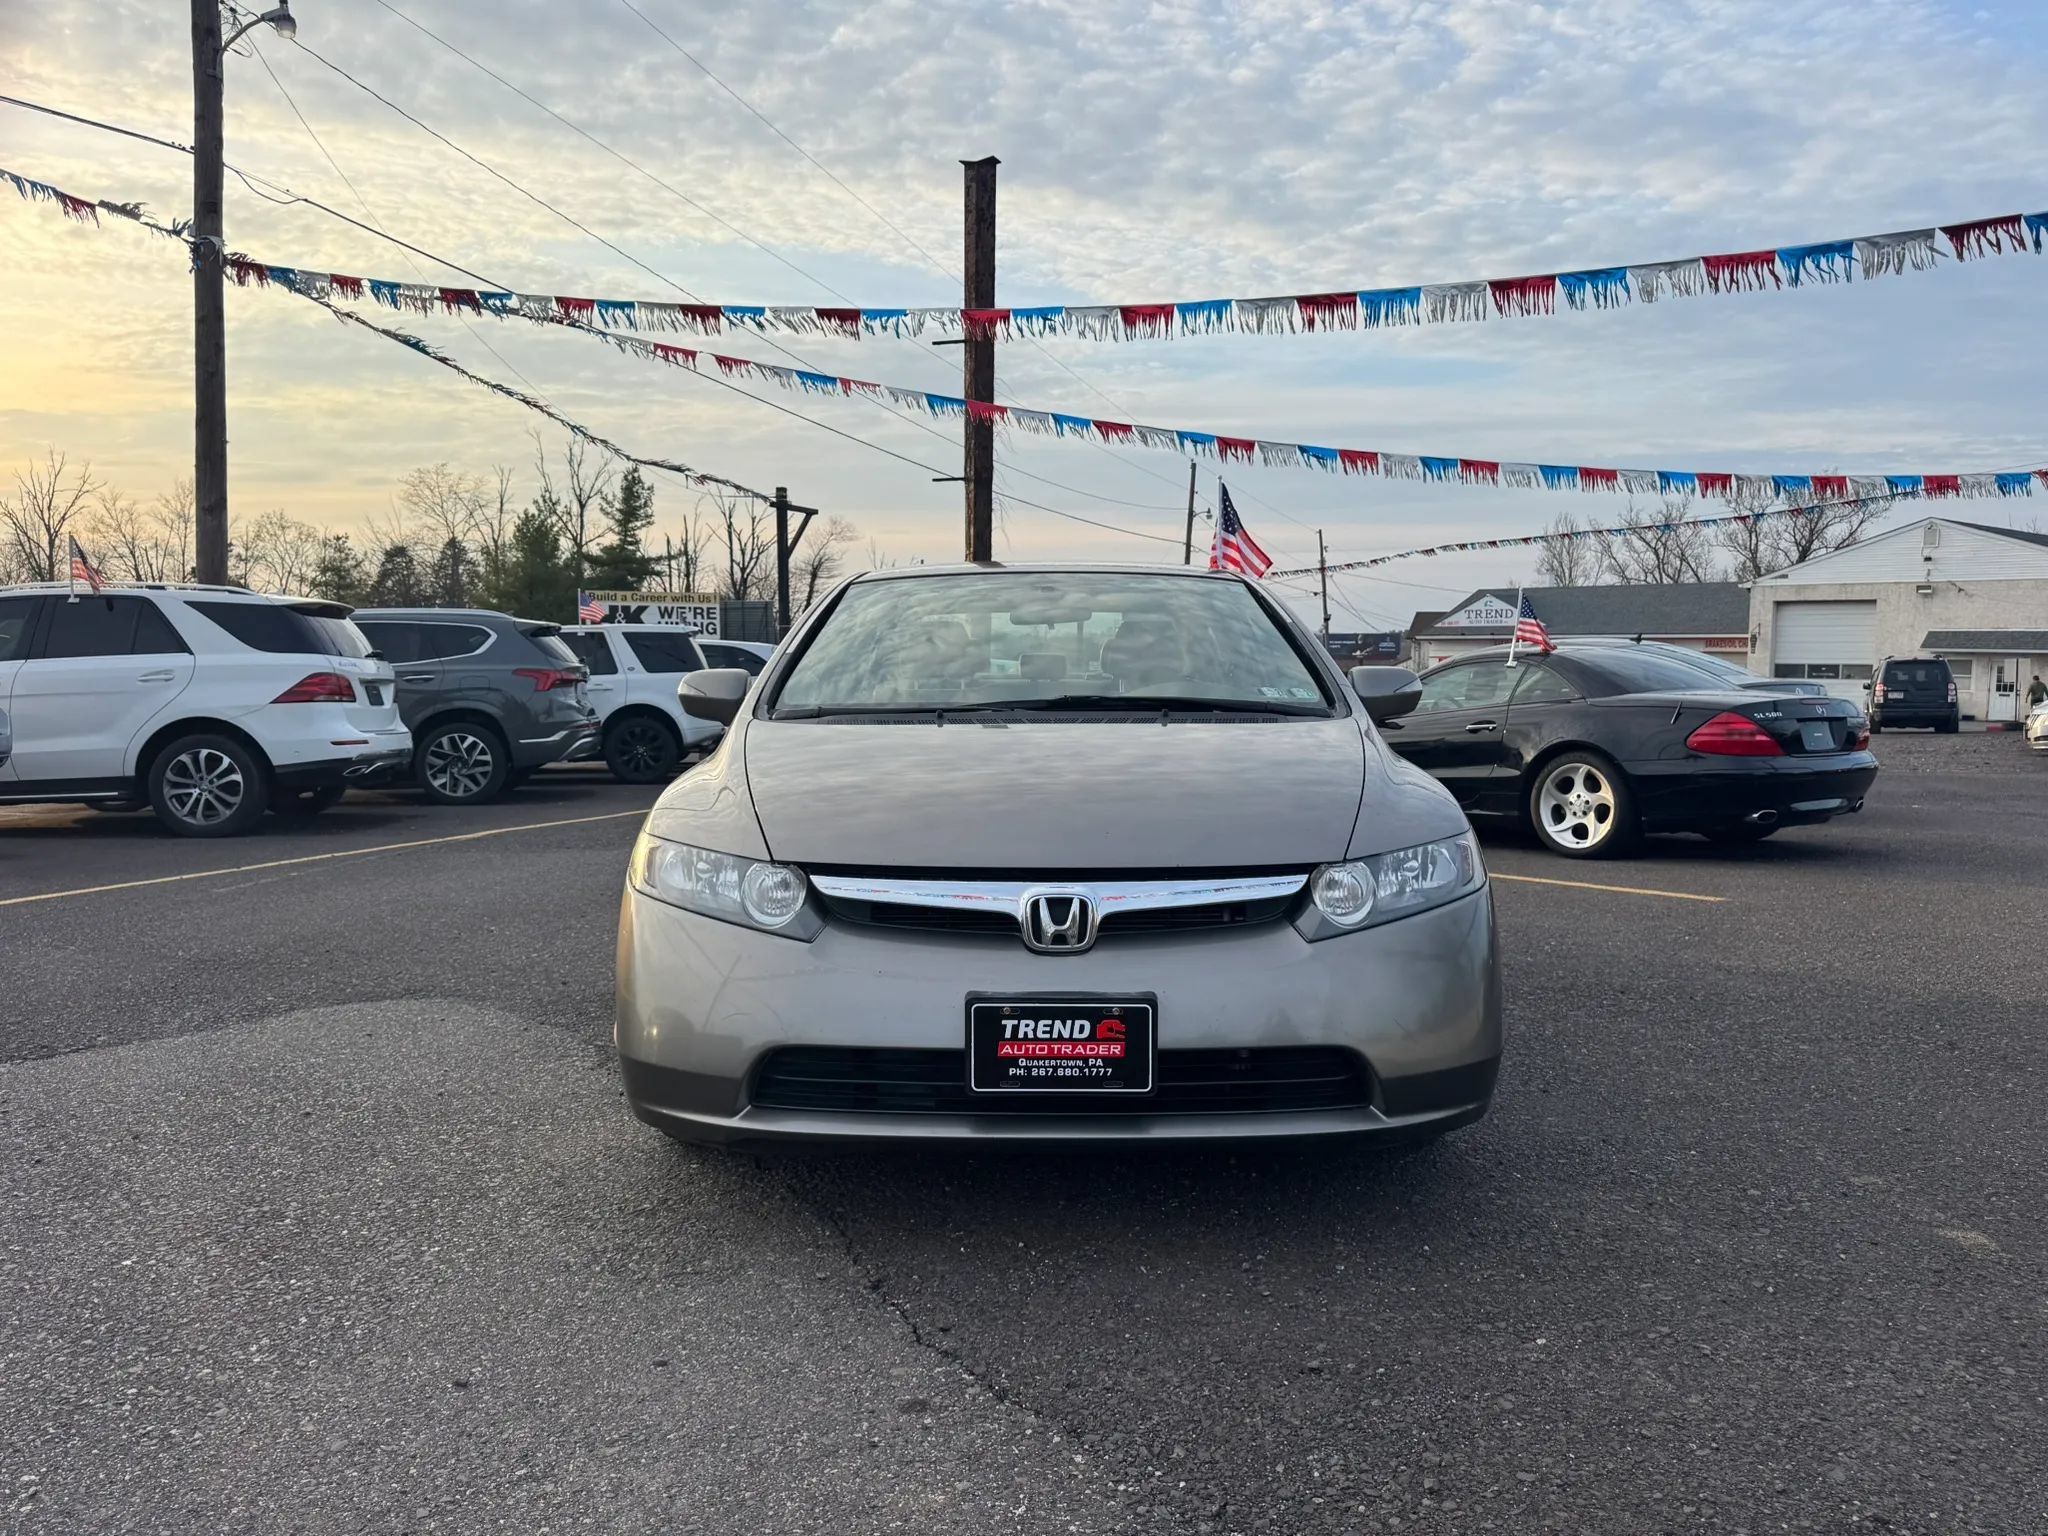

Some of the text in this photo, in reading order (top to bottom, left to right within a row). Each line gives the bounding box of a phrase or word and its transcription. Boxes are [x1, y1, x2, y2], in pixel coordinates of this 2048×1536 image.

[589, 592, 617, 601] Build
[631, 593, 668, 603] Career
[671, 594, 694, 603] with
[698, 594, 711, 603] Us
[658, 606, 717, 620] WE'RE
[1464, 609, 1514, 619] TREND
[1001, 1020, 1091, 1039] TREND
[1000, 1044, 1121, 1055] AUTO TRADER
[1088, 1059, 1104, 1067] PA
[1009, 1068, 1113, 1076] PH: 267.680.1777
